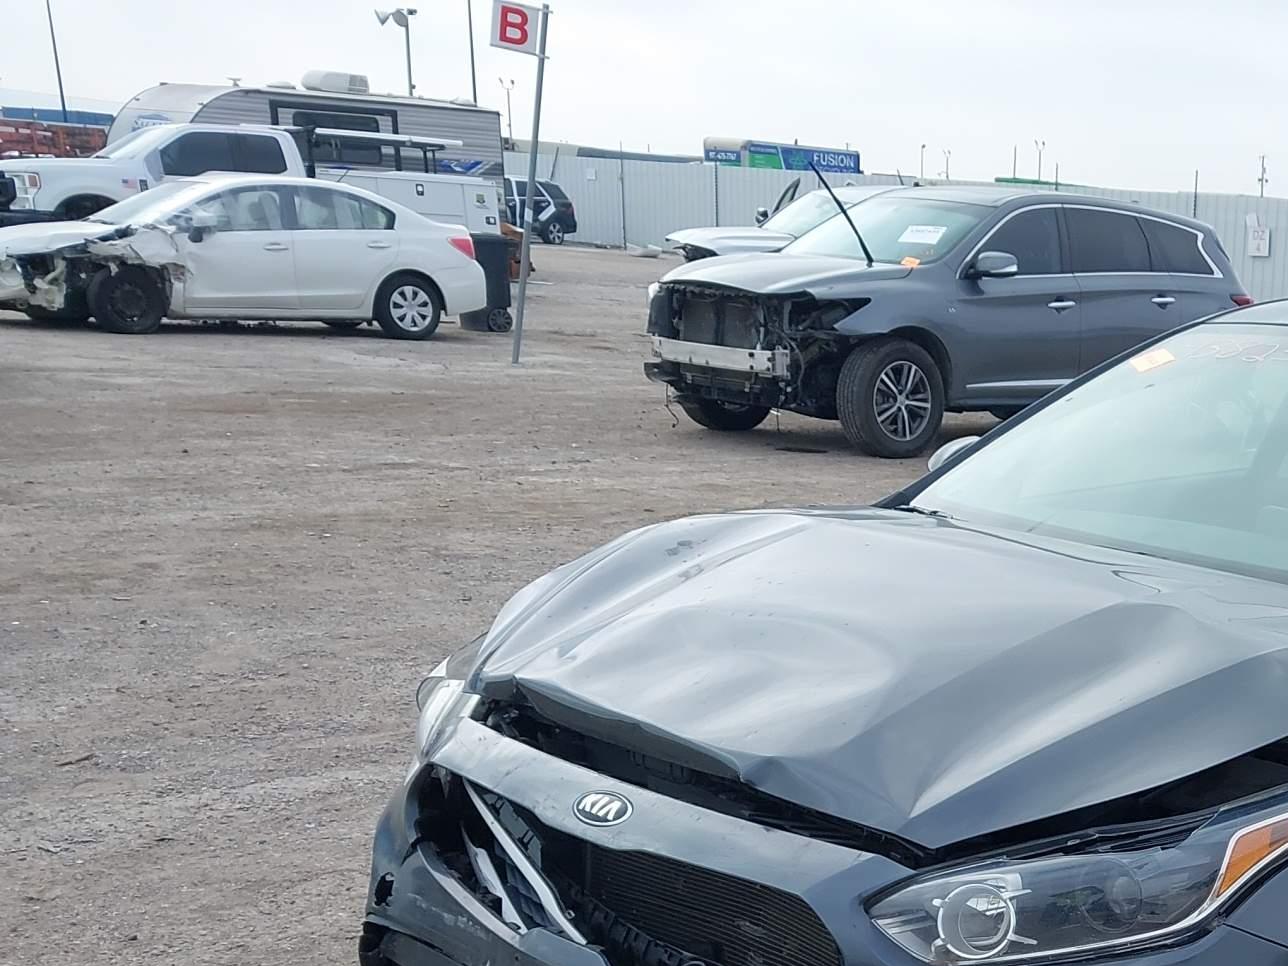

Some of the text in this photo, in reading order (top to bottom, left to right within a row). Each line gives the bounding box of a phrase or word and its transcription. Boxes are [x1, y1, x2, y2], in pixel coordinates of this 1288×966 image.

[499, 5, 528, 45] B
[813, 151, 855, 168] FUSION
[578, 794, 622, 821] KIA
